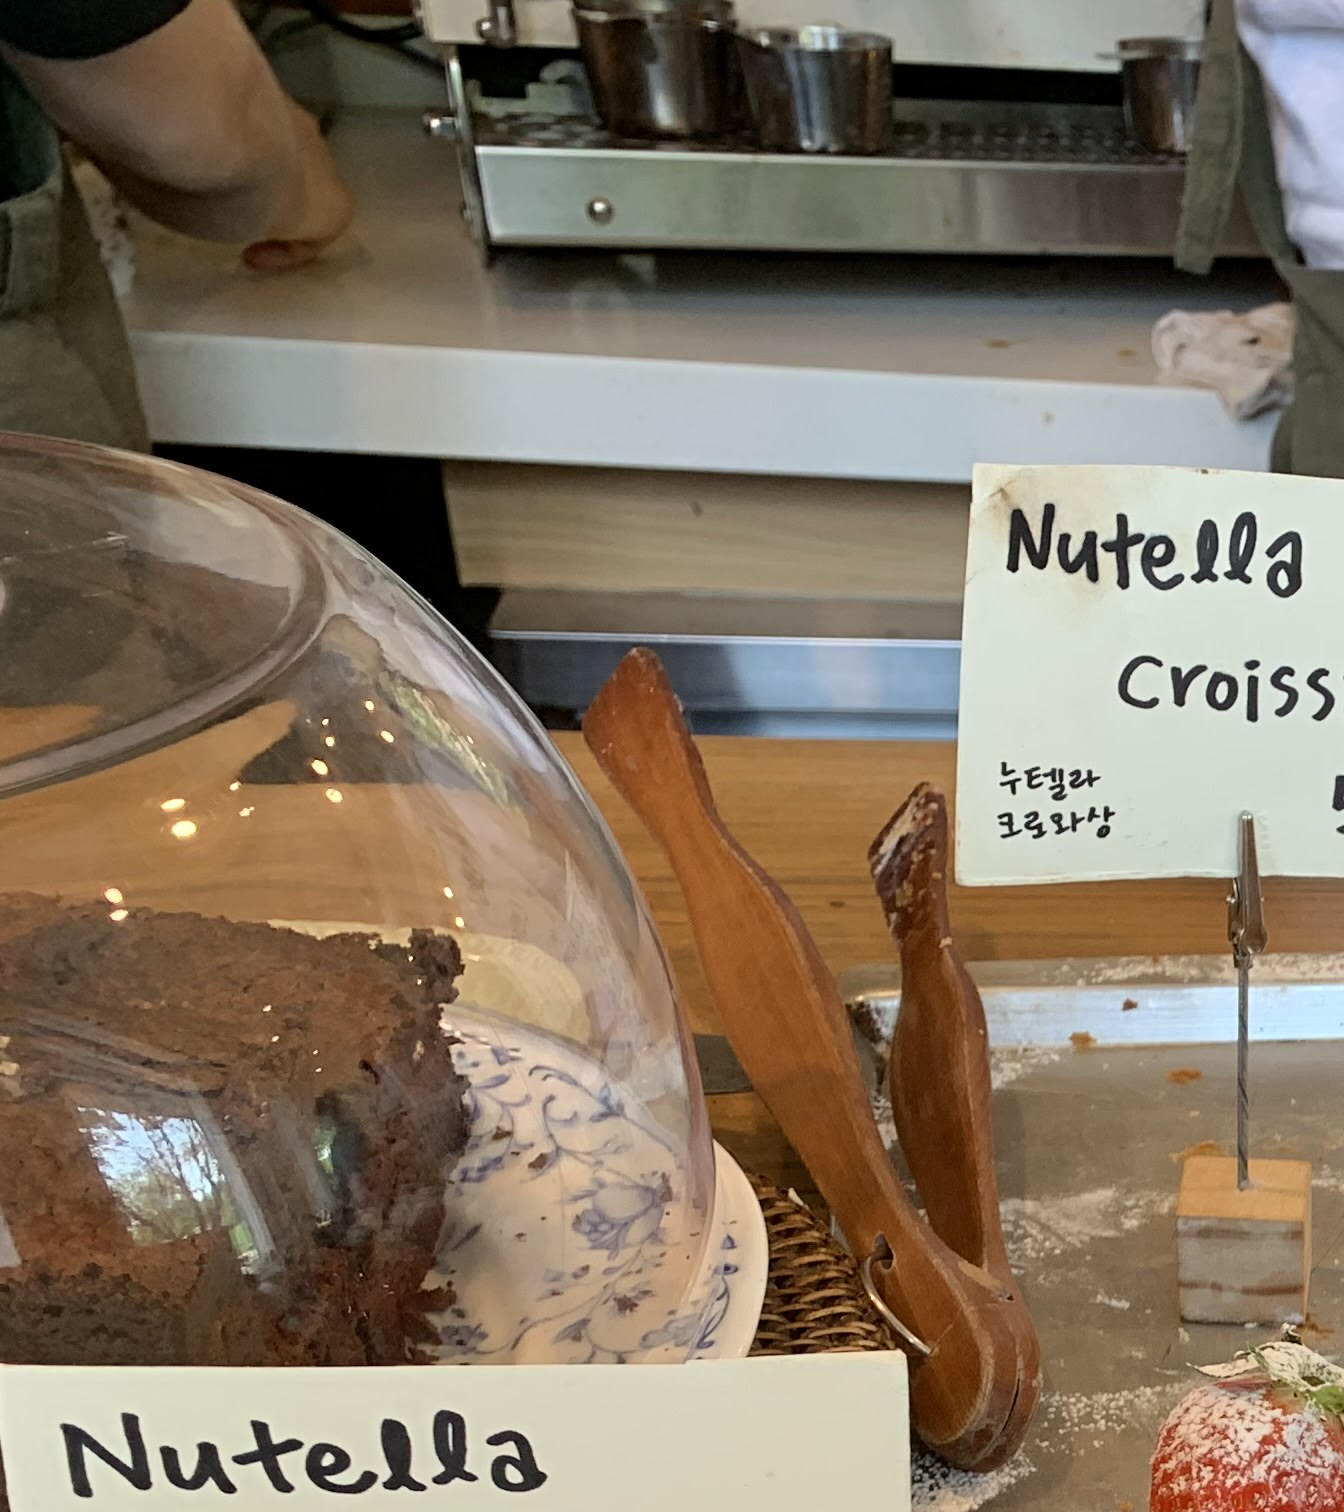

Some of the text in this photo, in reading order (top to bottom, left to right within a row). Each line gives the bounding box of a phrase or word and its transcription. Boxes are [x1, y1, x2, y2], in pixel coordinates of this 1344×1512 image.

[1005, 502, 1304, 600] Nutella
[998, 761, 1102, 802] 누텔라
[996, 805, 1117, 840] 크로와상
[59, 1409, 549, 1499] Nutella
